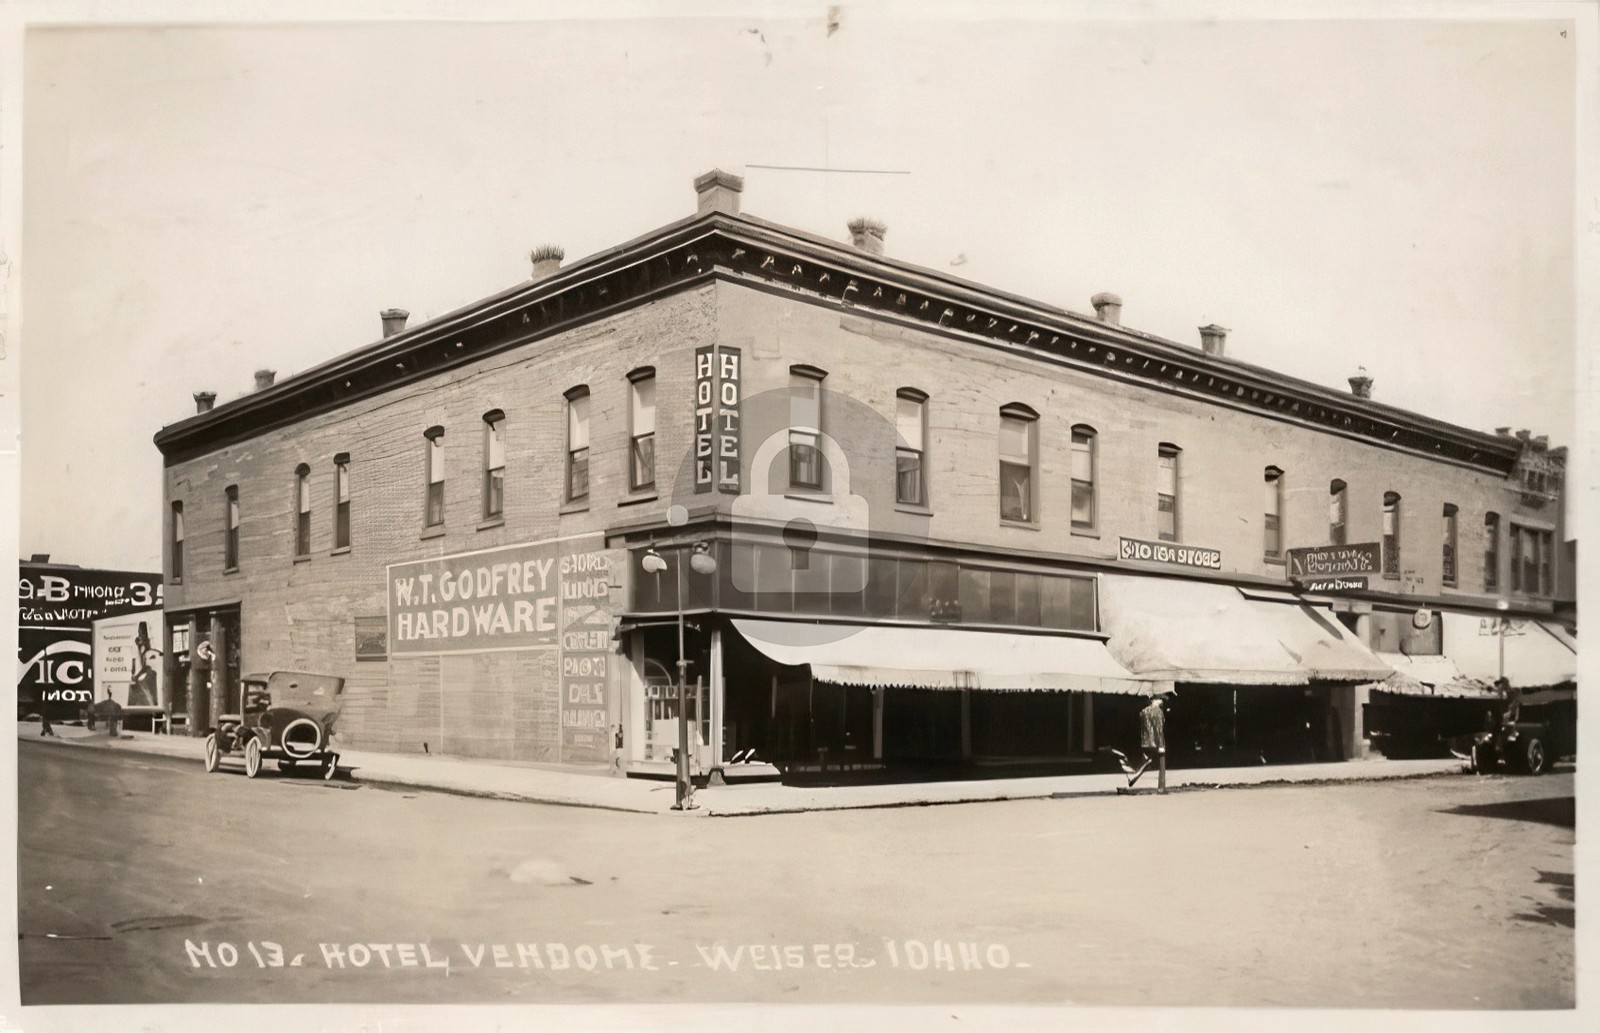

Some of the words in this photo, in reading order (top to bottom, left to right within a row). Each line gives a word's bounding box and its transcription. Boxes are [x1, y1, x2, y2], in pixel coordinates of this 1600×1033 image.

[696, 353, 713, 484] HOTEL
[719, 354, 739, 485] HOTEL
[397, 597, 557, 641] HARDWARE
[439, 558, 555, 602] GODFREY
